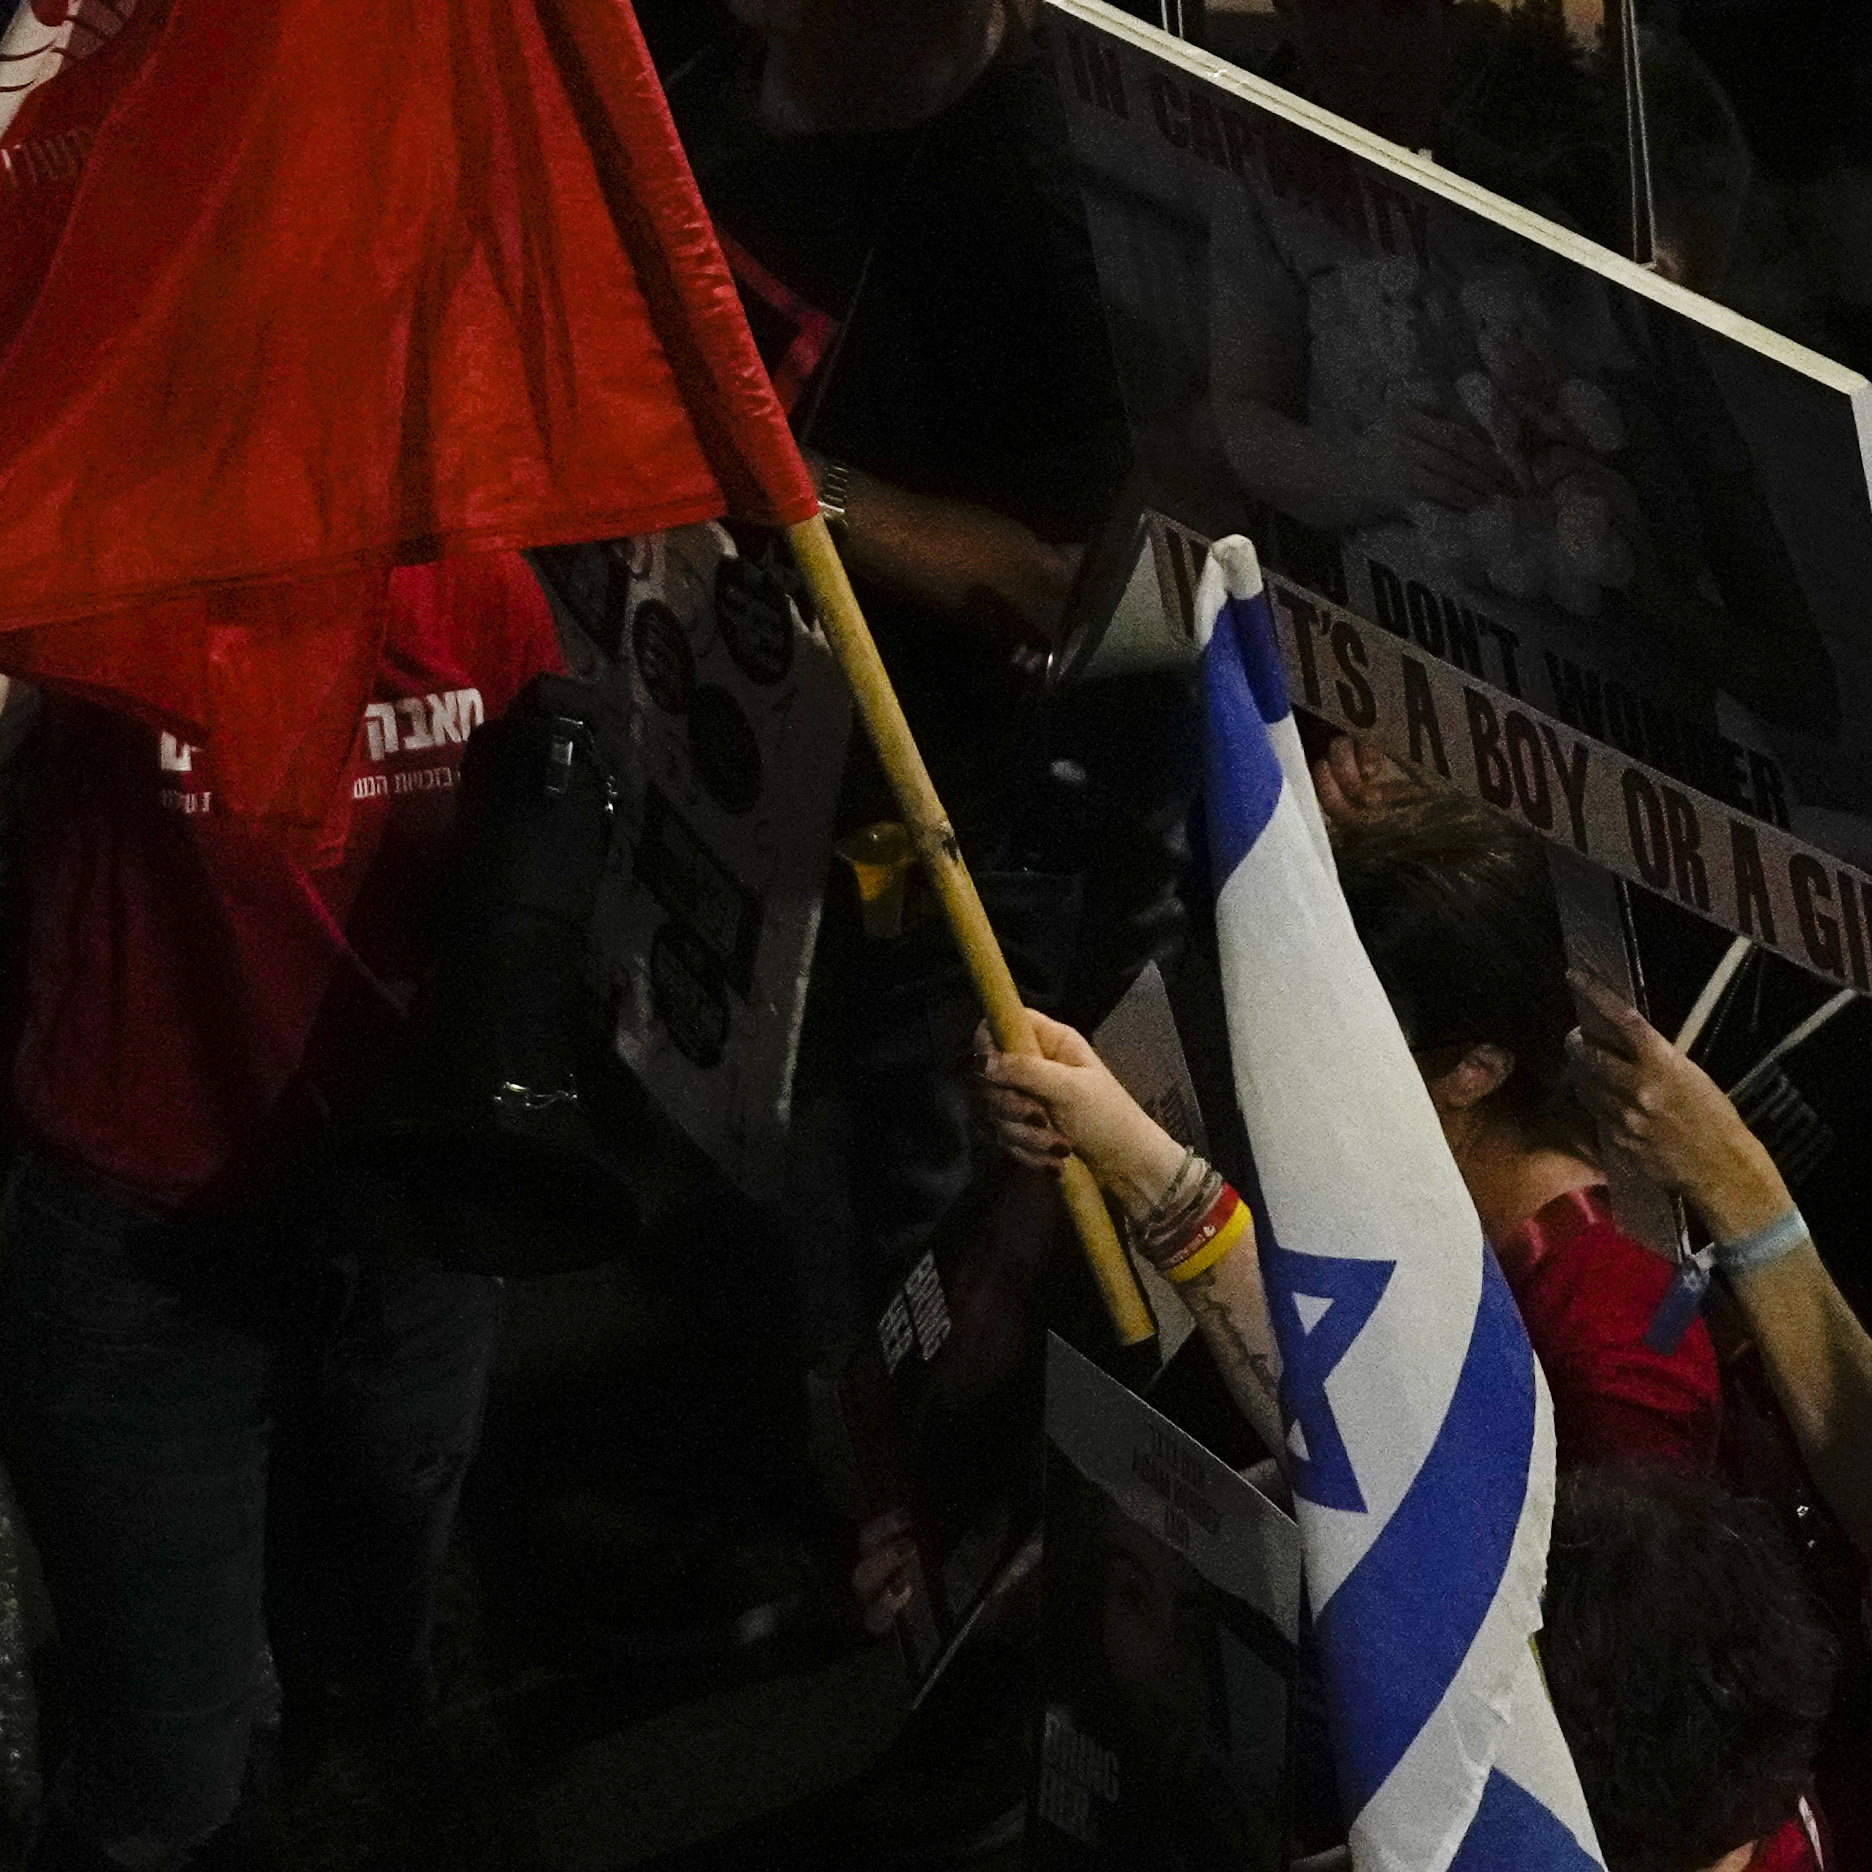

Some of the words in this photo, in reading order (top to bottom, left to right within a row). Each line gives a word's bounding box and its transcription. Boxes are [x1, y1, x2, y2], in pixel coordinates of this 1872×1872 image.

[1148, 70, 1435, 260] CAPTY
[1367, 556, 1526, 700] DON'T
[363, 686, 486, 763] מאבק
[1264, 578, 1377, 729] T'S
[1401, 653, 1451, 778] A
[1463, 687, 1592, 856] BOY
[1621, 767, 1712, 914] OR
[1728, 817, 1779, 947] A
